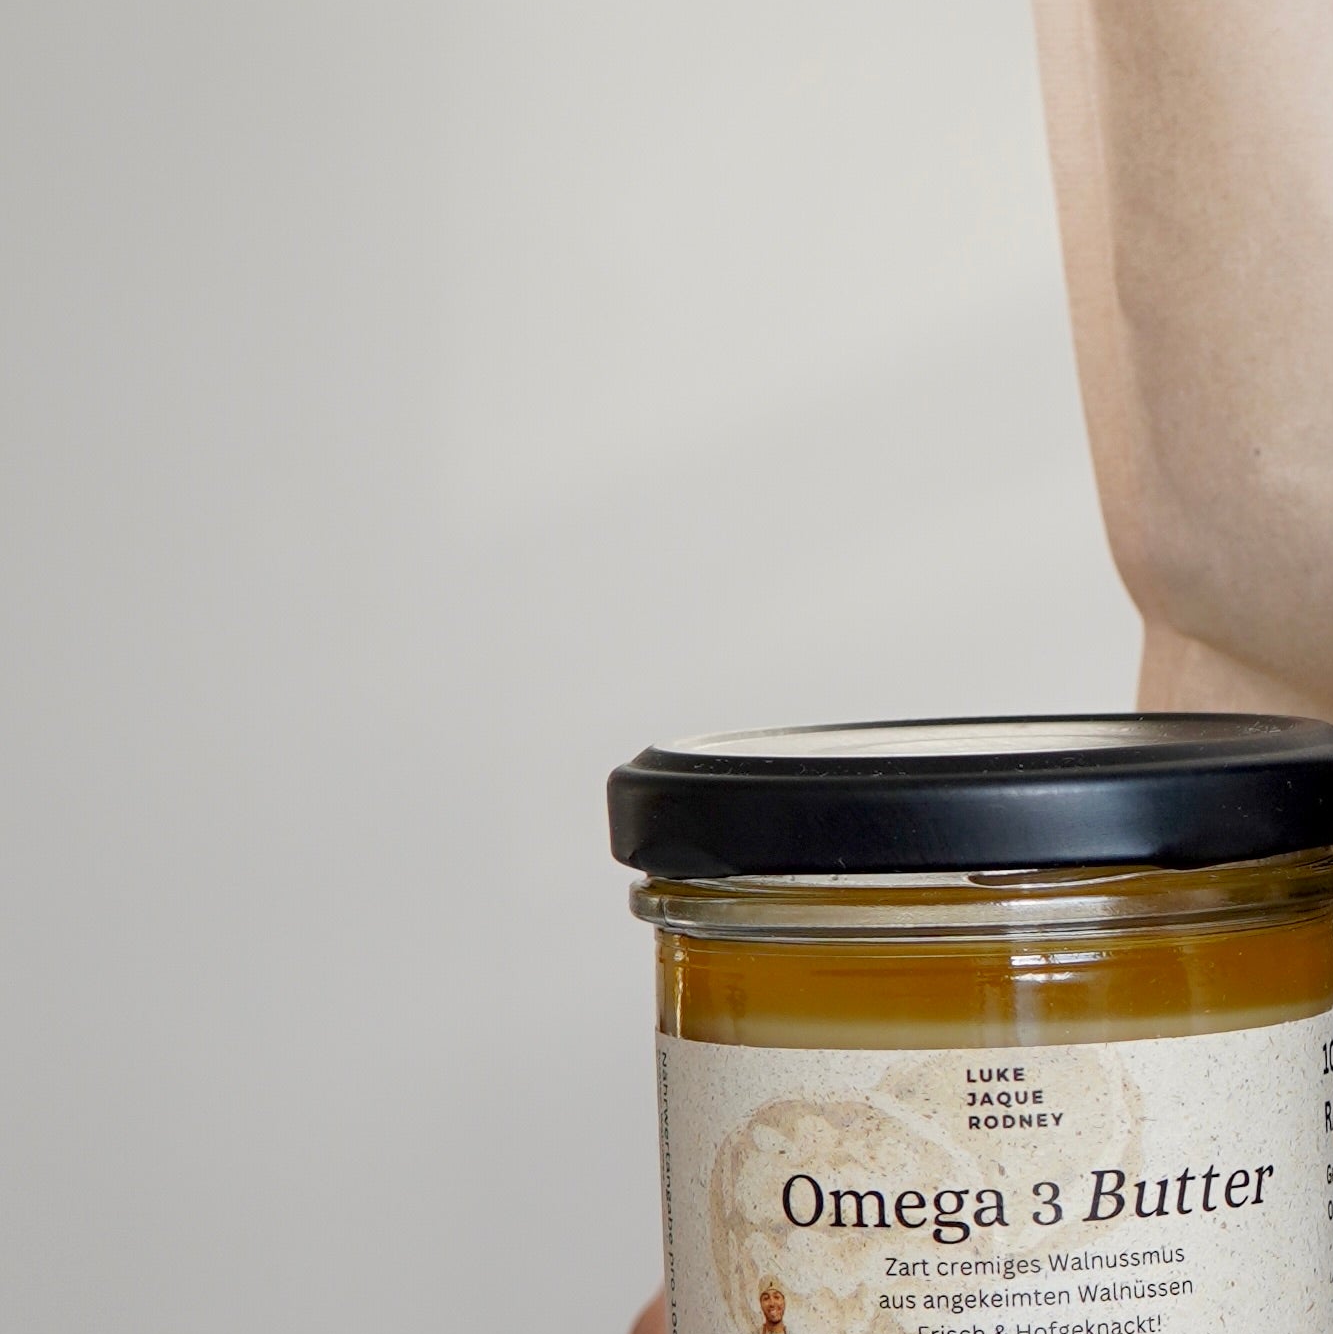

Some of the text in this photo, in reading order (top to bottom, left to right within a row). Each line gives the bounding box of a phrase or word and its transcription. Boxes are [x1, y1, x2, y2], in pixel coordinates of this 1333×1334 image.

[966, 1067, 1025, 1083] LUKE
[966, 1090, 1044, 1108] JAQUE
[968, 1113, 1064, 1129] RODNEY
[782, 1164, 1274, 1244] Omega 3 Butter
[885, 1247, 1185, 1280] Zart cremiges Walnussmus
[879, 1278, 1193, 1313] aus angekeimten Walnüssen
